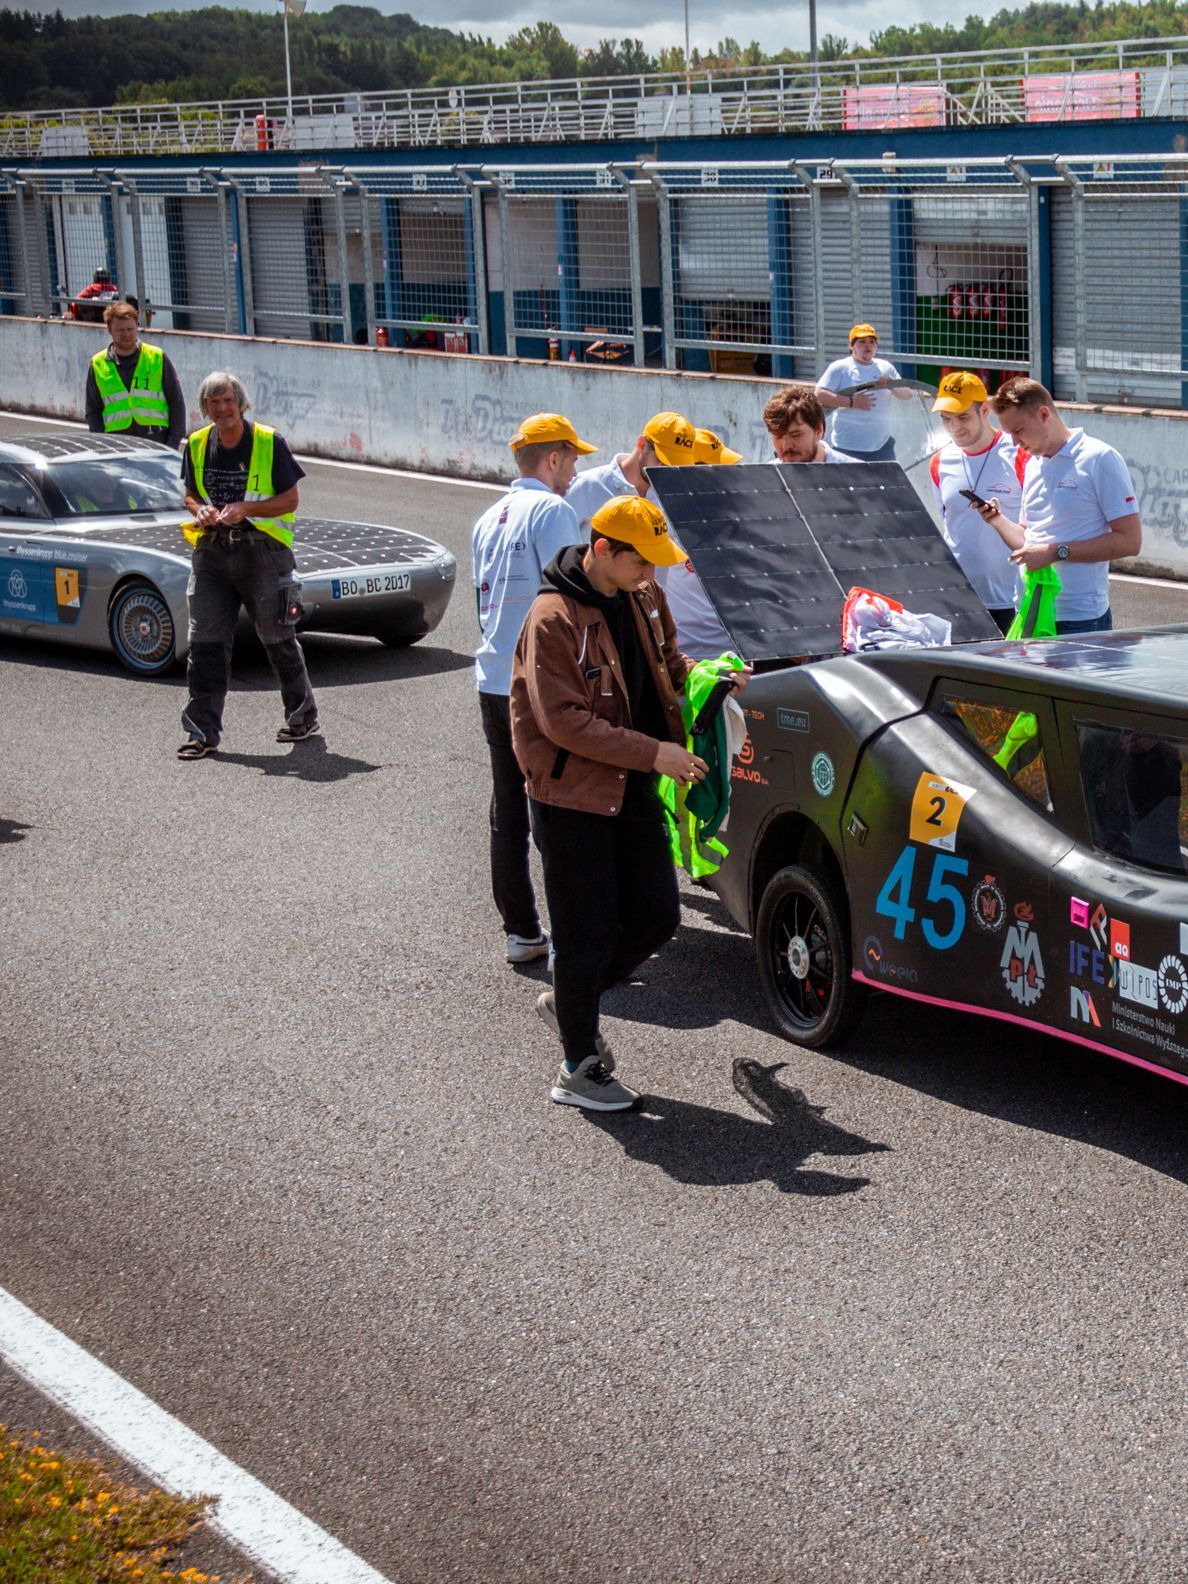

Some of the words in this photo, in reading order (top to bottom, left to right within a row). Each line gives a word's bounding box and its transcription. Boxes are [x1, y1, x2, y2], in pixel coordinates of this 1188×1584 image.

[64, 579, 70, 595] 1
[341, 580, 358, 596] BO
[366, 577, 382, 594] BC
[384, 574, 410, 591] 2017
[780, 713, 806, 728] tme.eu
[926, 795, 946, 827] 2
[875, 845, 970, 950] 45
[1166, 977, 1182, 990] IMP
[1111, 1001, 1155, 1029] Ministerstwo
[1155, 1017, 1176, 1036] Nauki
[1115, 1018, 1155, 1043] Szkolnictwa
